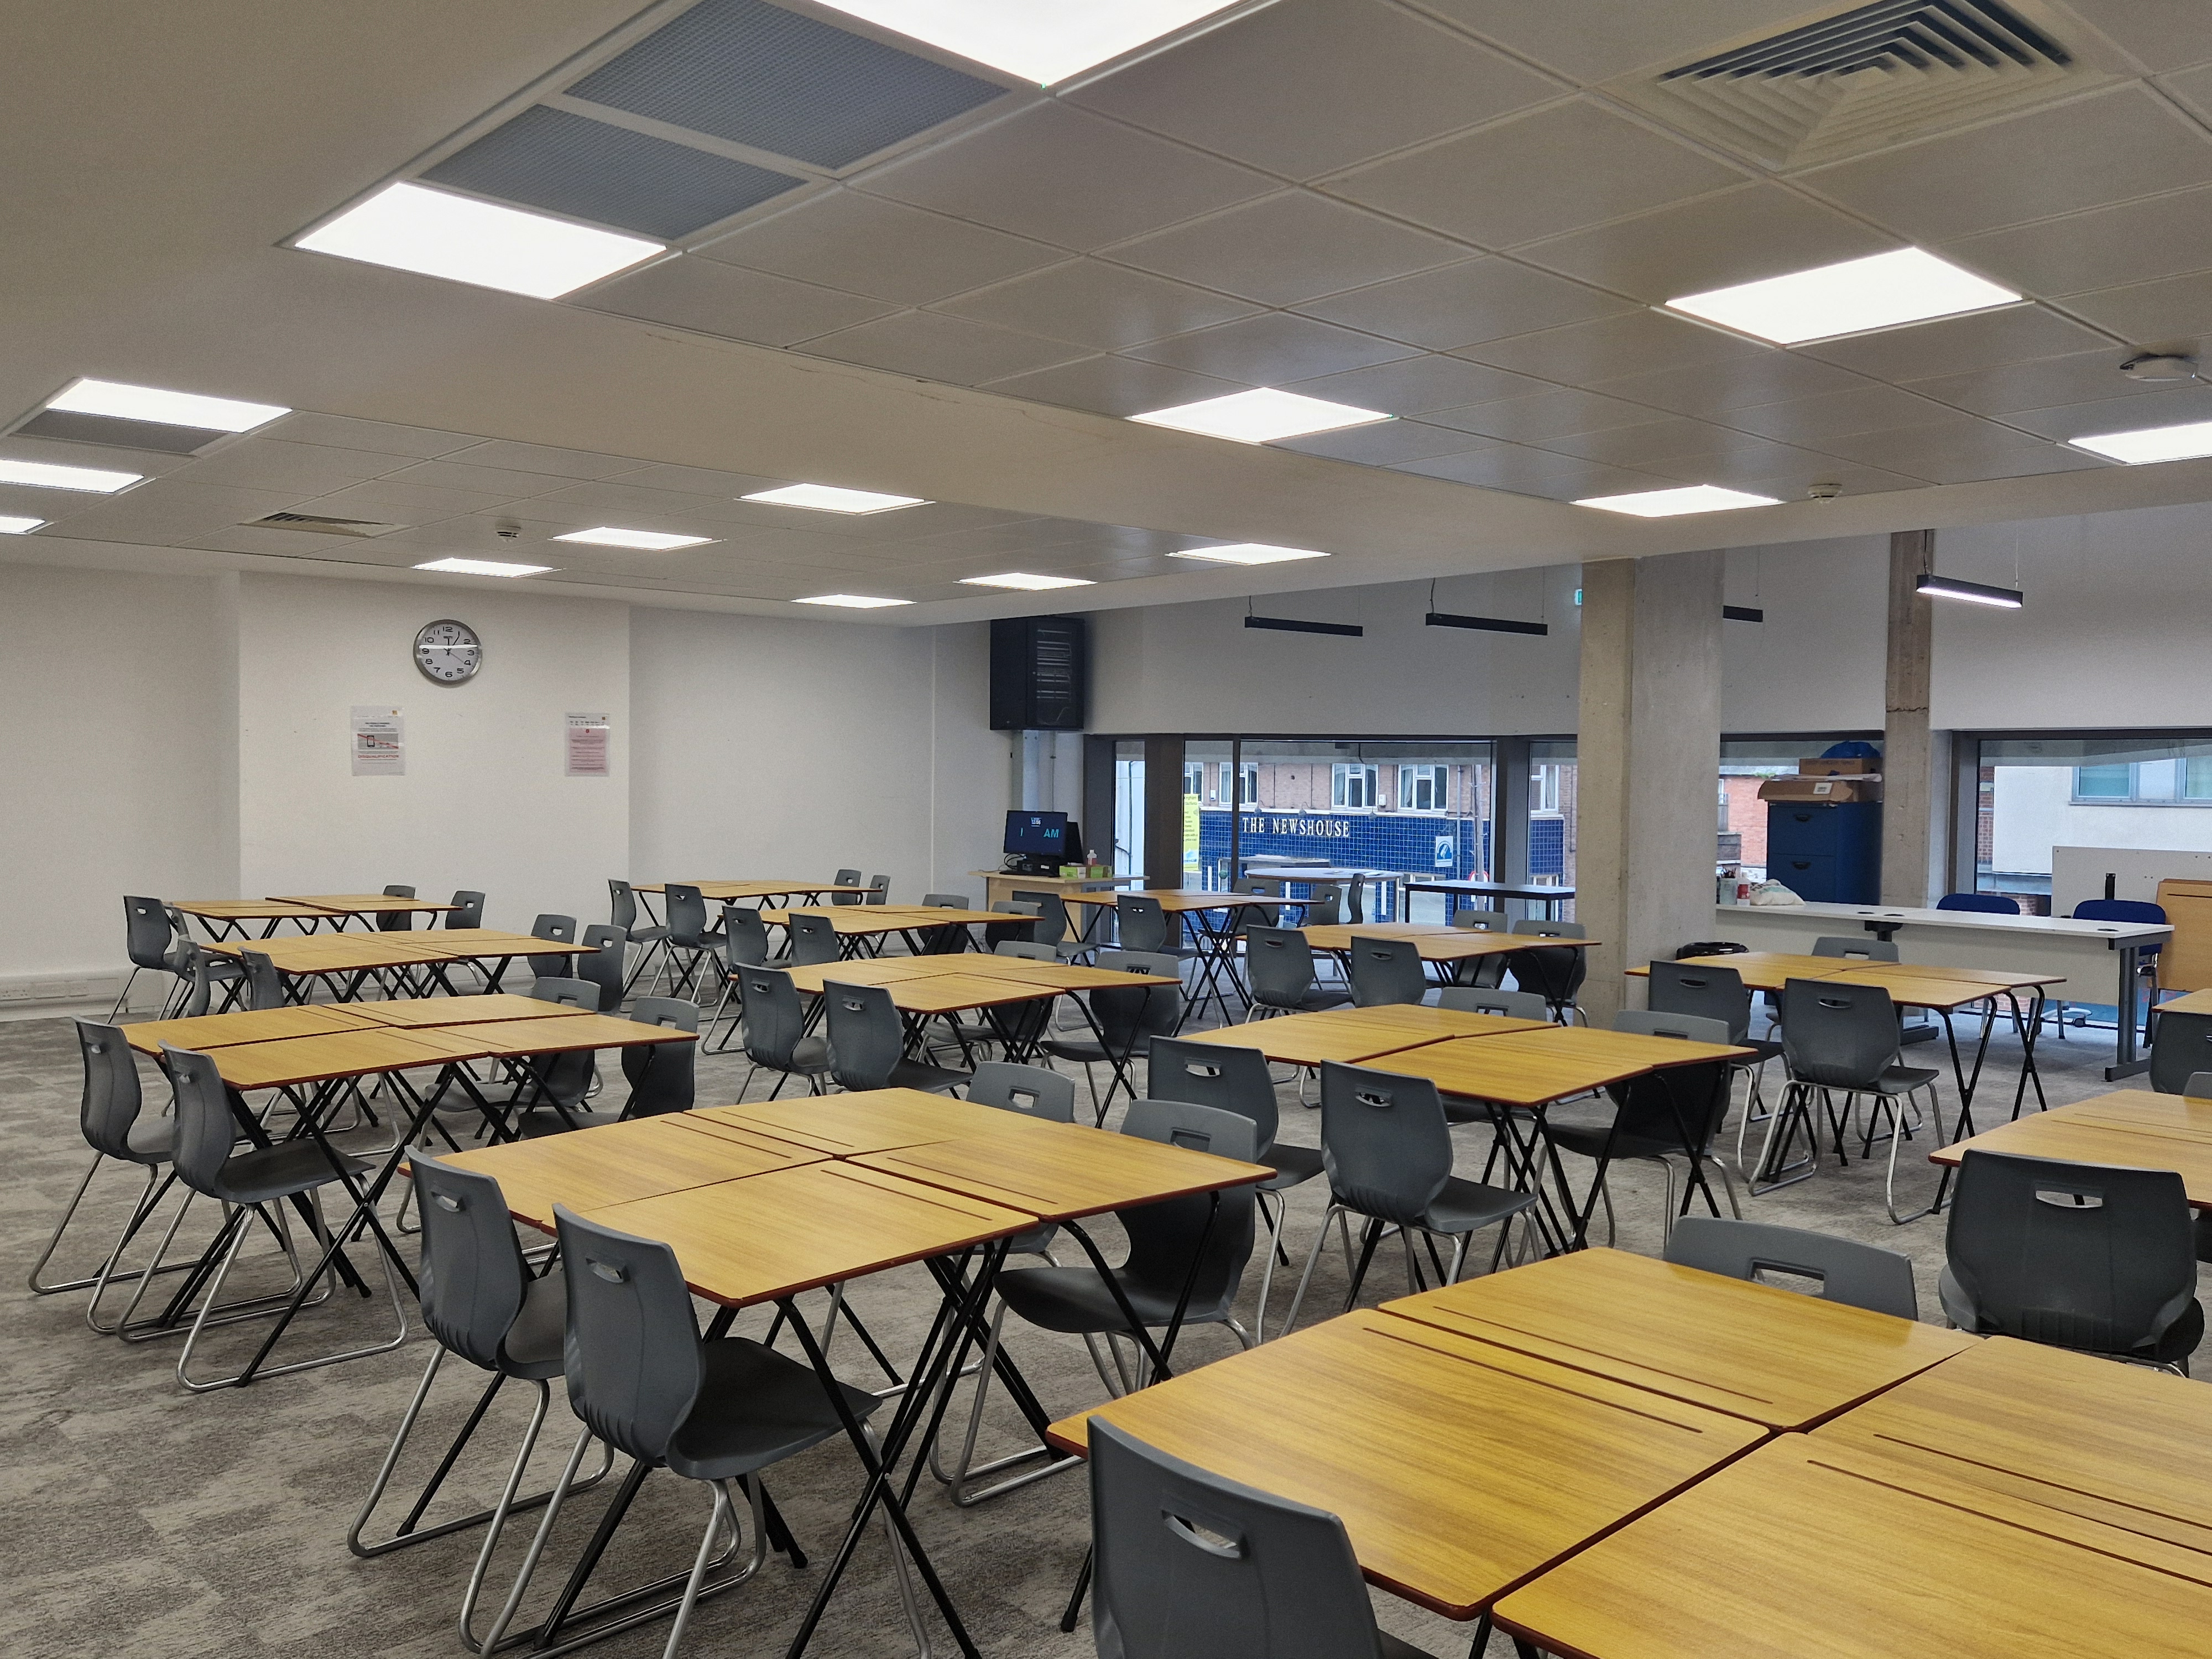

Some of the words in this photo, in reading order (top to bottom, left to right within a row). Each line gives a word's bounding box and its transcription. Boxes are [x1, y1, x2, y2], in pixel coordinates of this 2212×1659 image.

[1043, 828, 1059, 838] AM
[1243, 817, 1265, 833] THE
[1272, 818, 1349, 837] NEWSHOUSE
